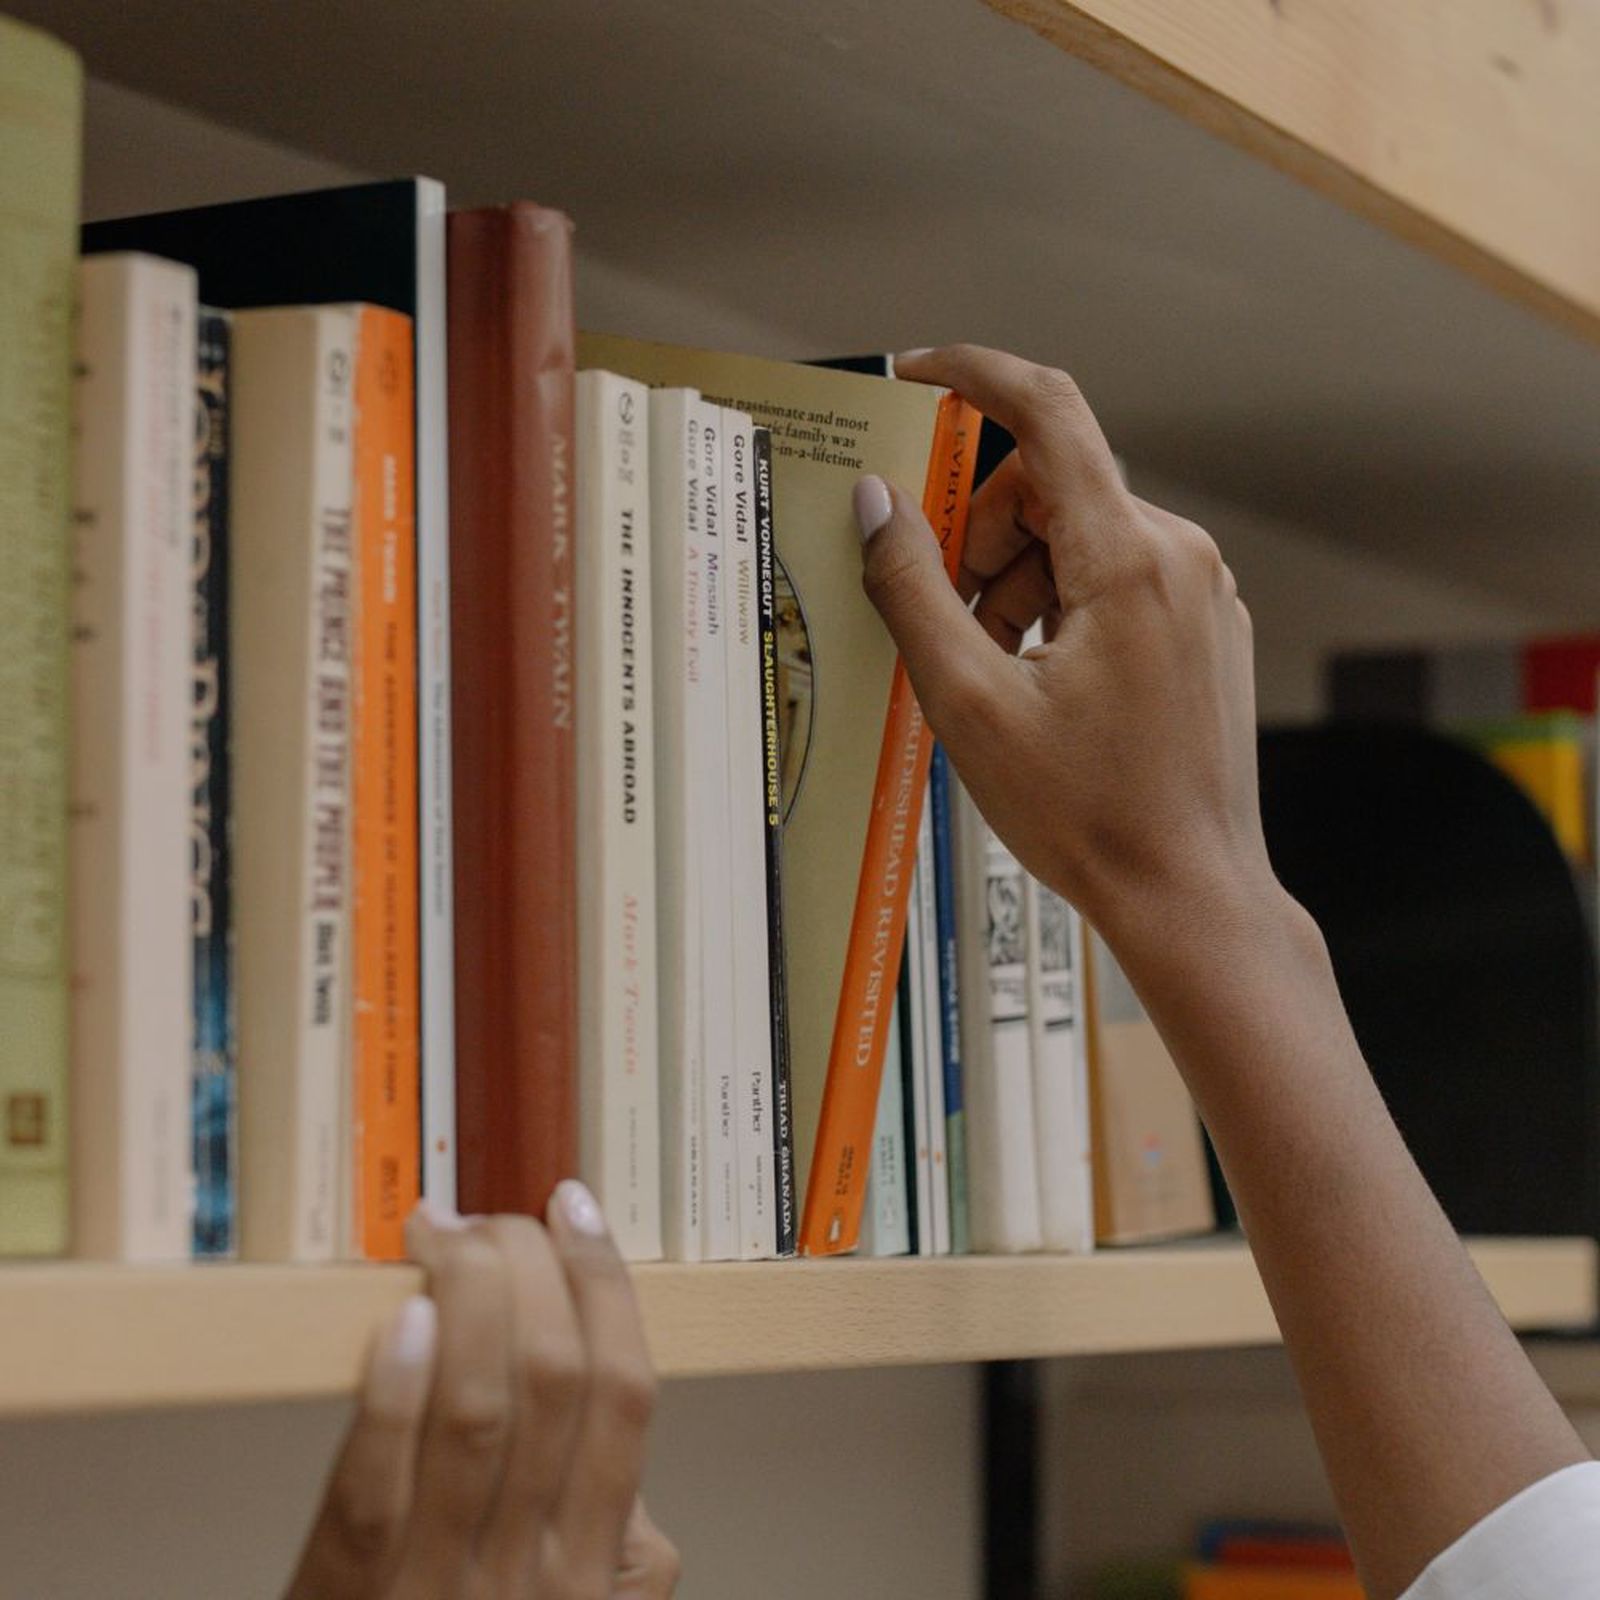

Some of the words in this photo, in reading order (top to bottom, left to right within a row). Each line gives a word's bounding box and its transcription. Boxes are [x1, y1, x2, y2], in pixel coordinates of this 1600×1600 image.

[736, 399, 805, 421] passionate
[807, 411, 833, 426] and
[835, 416, 870, 431] most
[784, 423, 827, 444] family
[831, 434, 856, 449] was
[688, 419, 699, 470] Gore
[704, 426, 717, 478] Gore
[734, 433, 747, 483] Gore
[688, 478, 700, 532] Vidal
[705, 485, 718, 538] Vidal
[759, 458, 770, 511] KURT
[620, 509, 635, 554] THE
[736, 491, 749, 543] Vidal
[706, 551, 720, 637] Messiah
[761, 515, 773, 620] VONNEGUT
[738, 559, 752, 646] Williwaw
[552, 587, 572, 730] TWAIN
[620, 566, 636, 710] INNOCENTS
[763, 631, 779, 807] SLAUGHTERHOUSE
[622, 720, 637, 824] ABROAD
[768, 813, 780, 827] 5
[855, 906, 894, 1067] REVISITED
[779, 1079, 789, 1139] TRIAD
[781, 1146, 793, 1237] GRANADA
